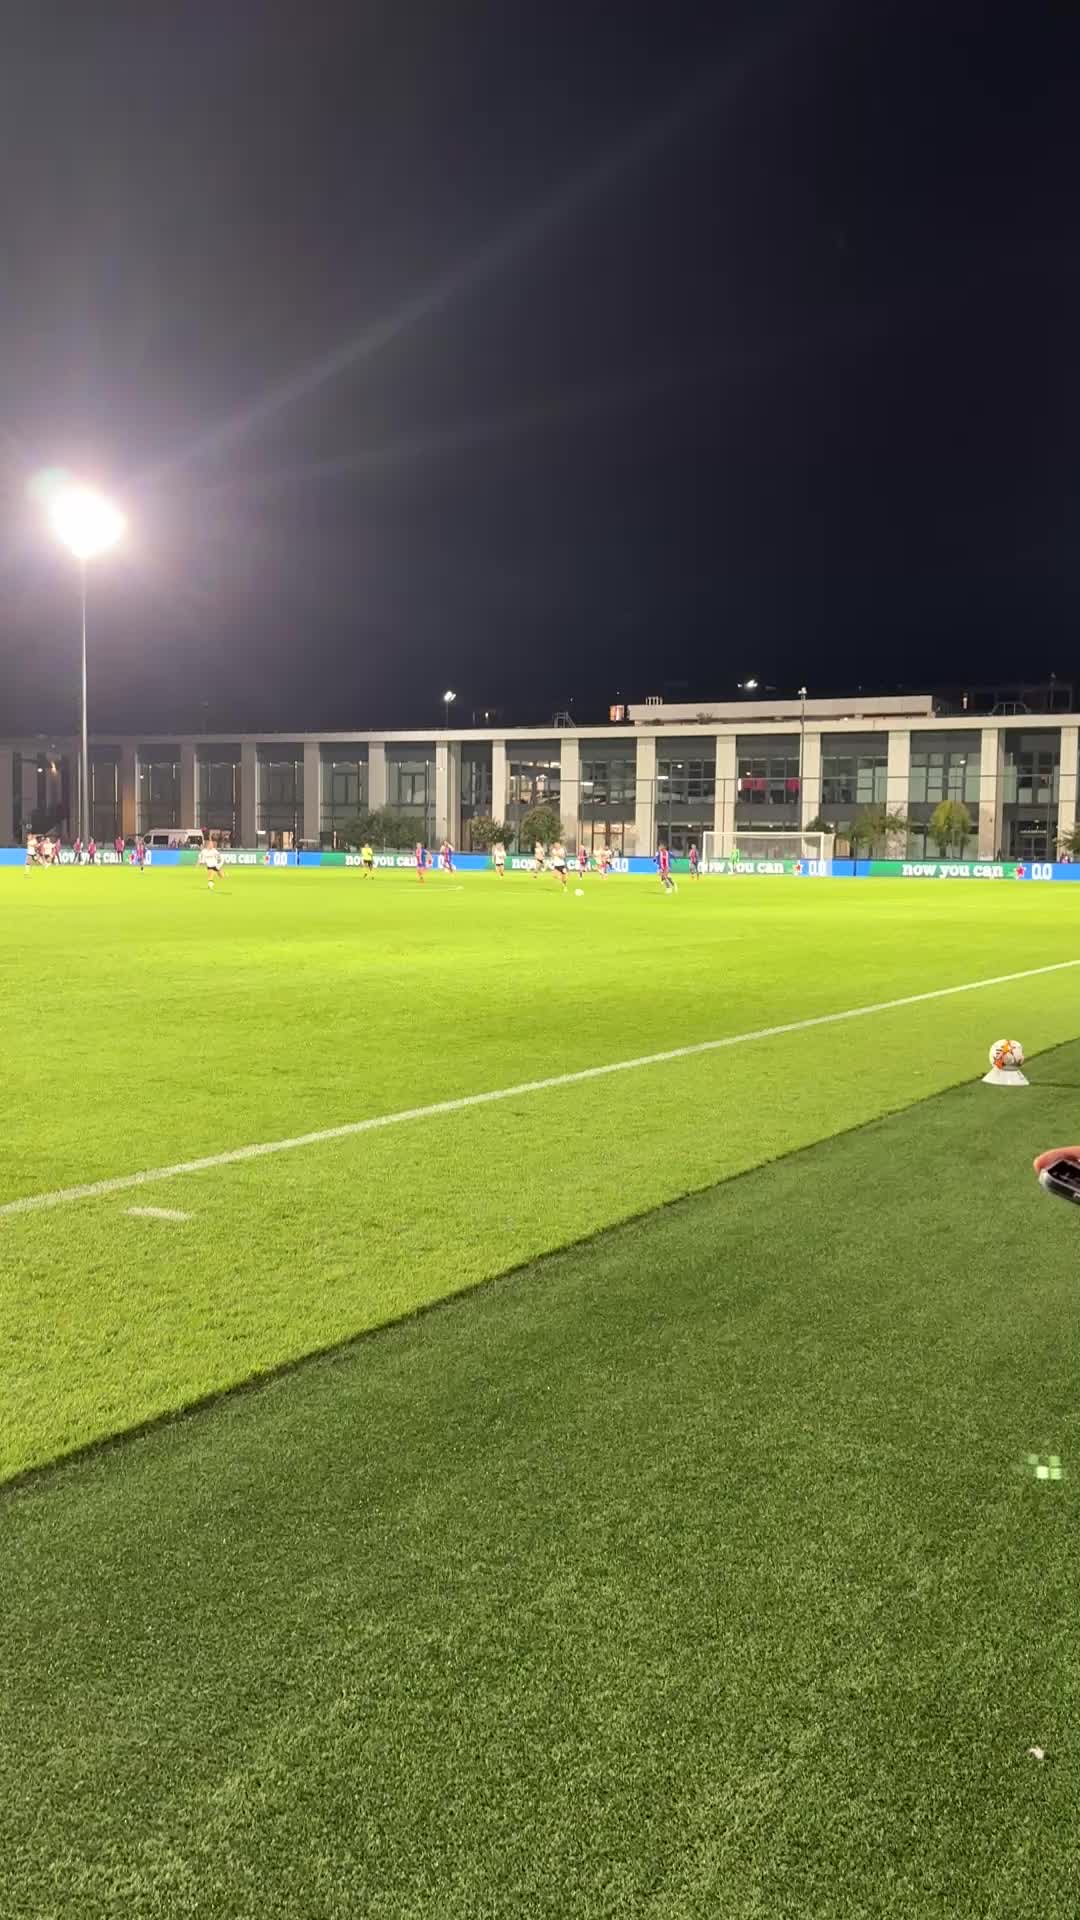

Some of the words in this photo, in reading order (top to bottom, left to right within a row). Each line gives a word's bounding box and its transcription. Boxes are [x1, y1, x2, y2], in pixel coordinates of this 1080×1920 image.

[238, 853, 257, 864] can
[757, 861, 784, 873] can
[902, 864, 937, 876] now
[938, 864, 970, 878] you
[973, 864, 1004, 877] can
